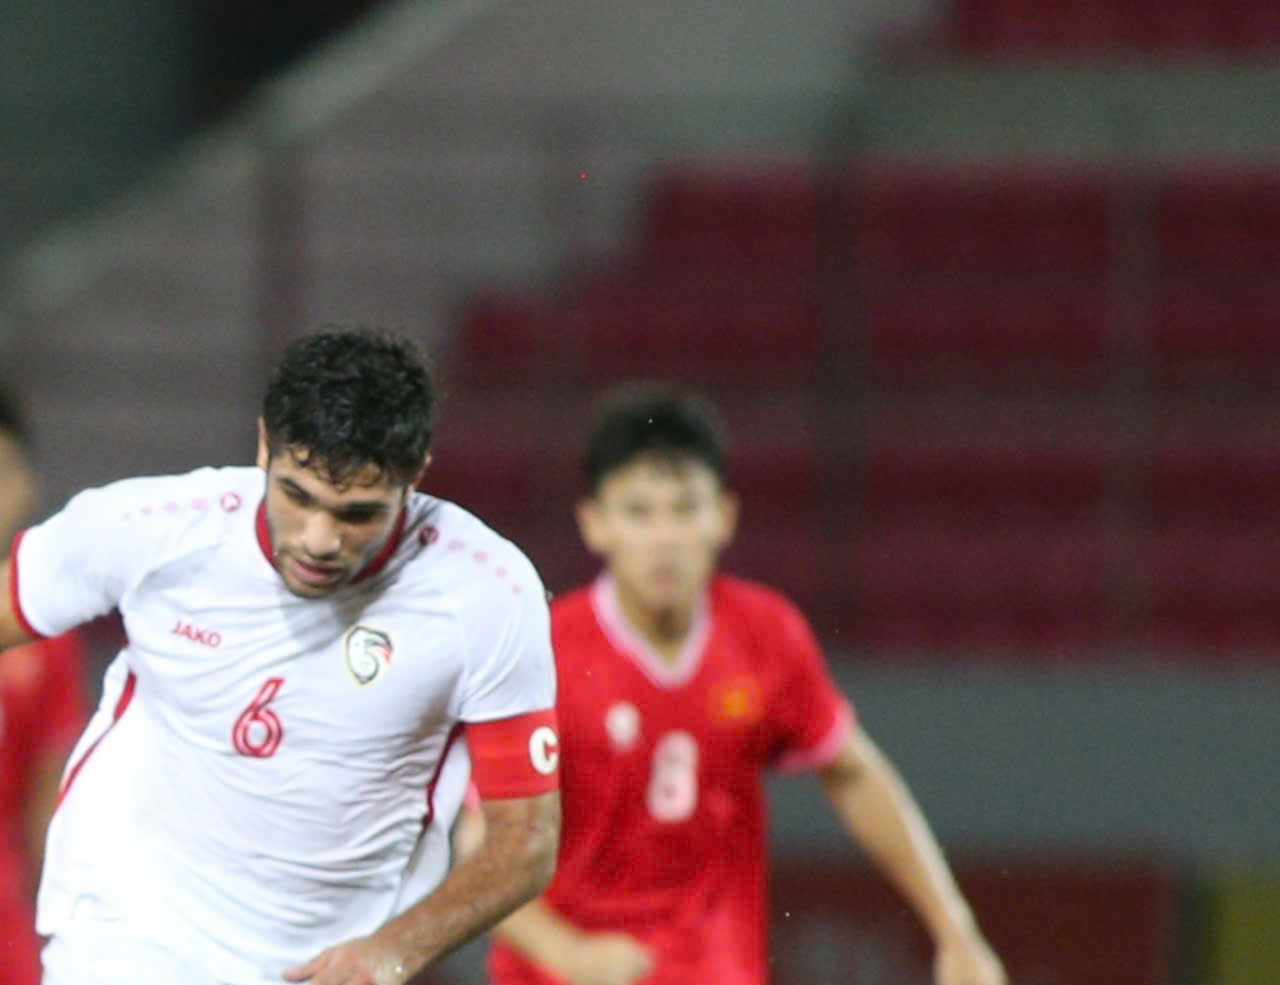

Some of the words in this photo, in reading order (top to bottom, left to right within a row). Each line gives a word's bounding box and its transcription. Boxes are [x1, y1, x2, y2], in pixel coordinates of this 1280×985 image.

[171, 619, 222, 649] JAKO
[232, 677, 286, 758] 6
[528, 726, 560, 776] C
[648, 730, 699, 824] 8
